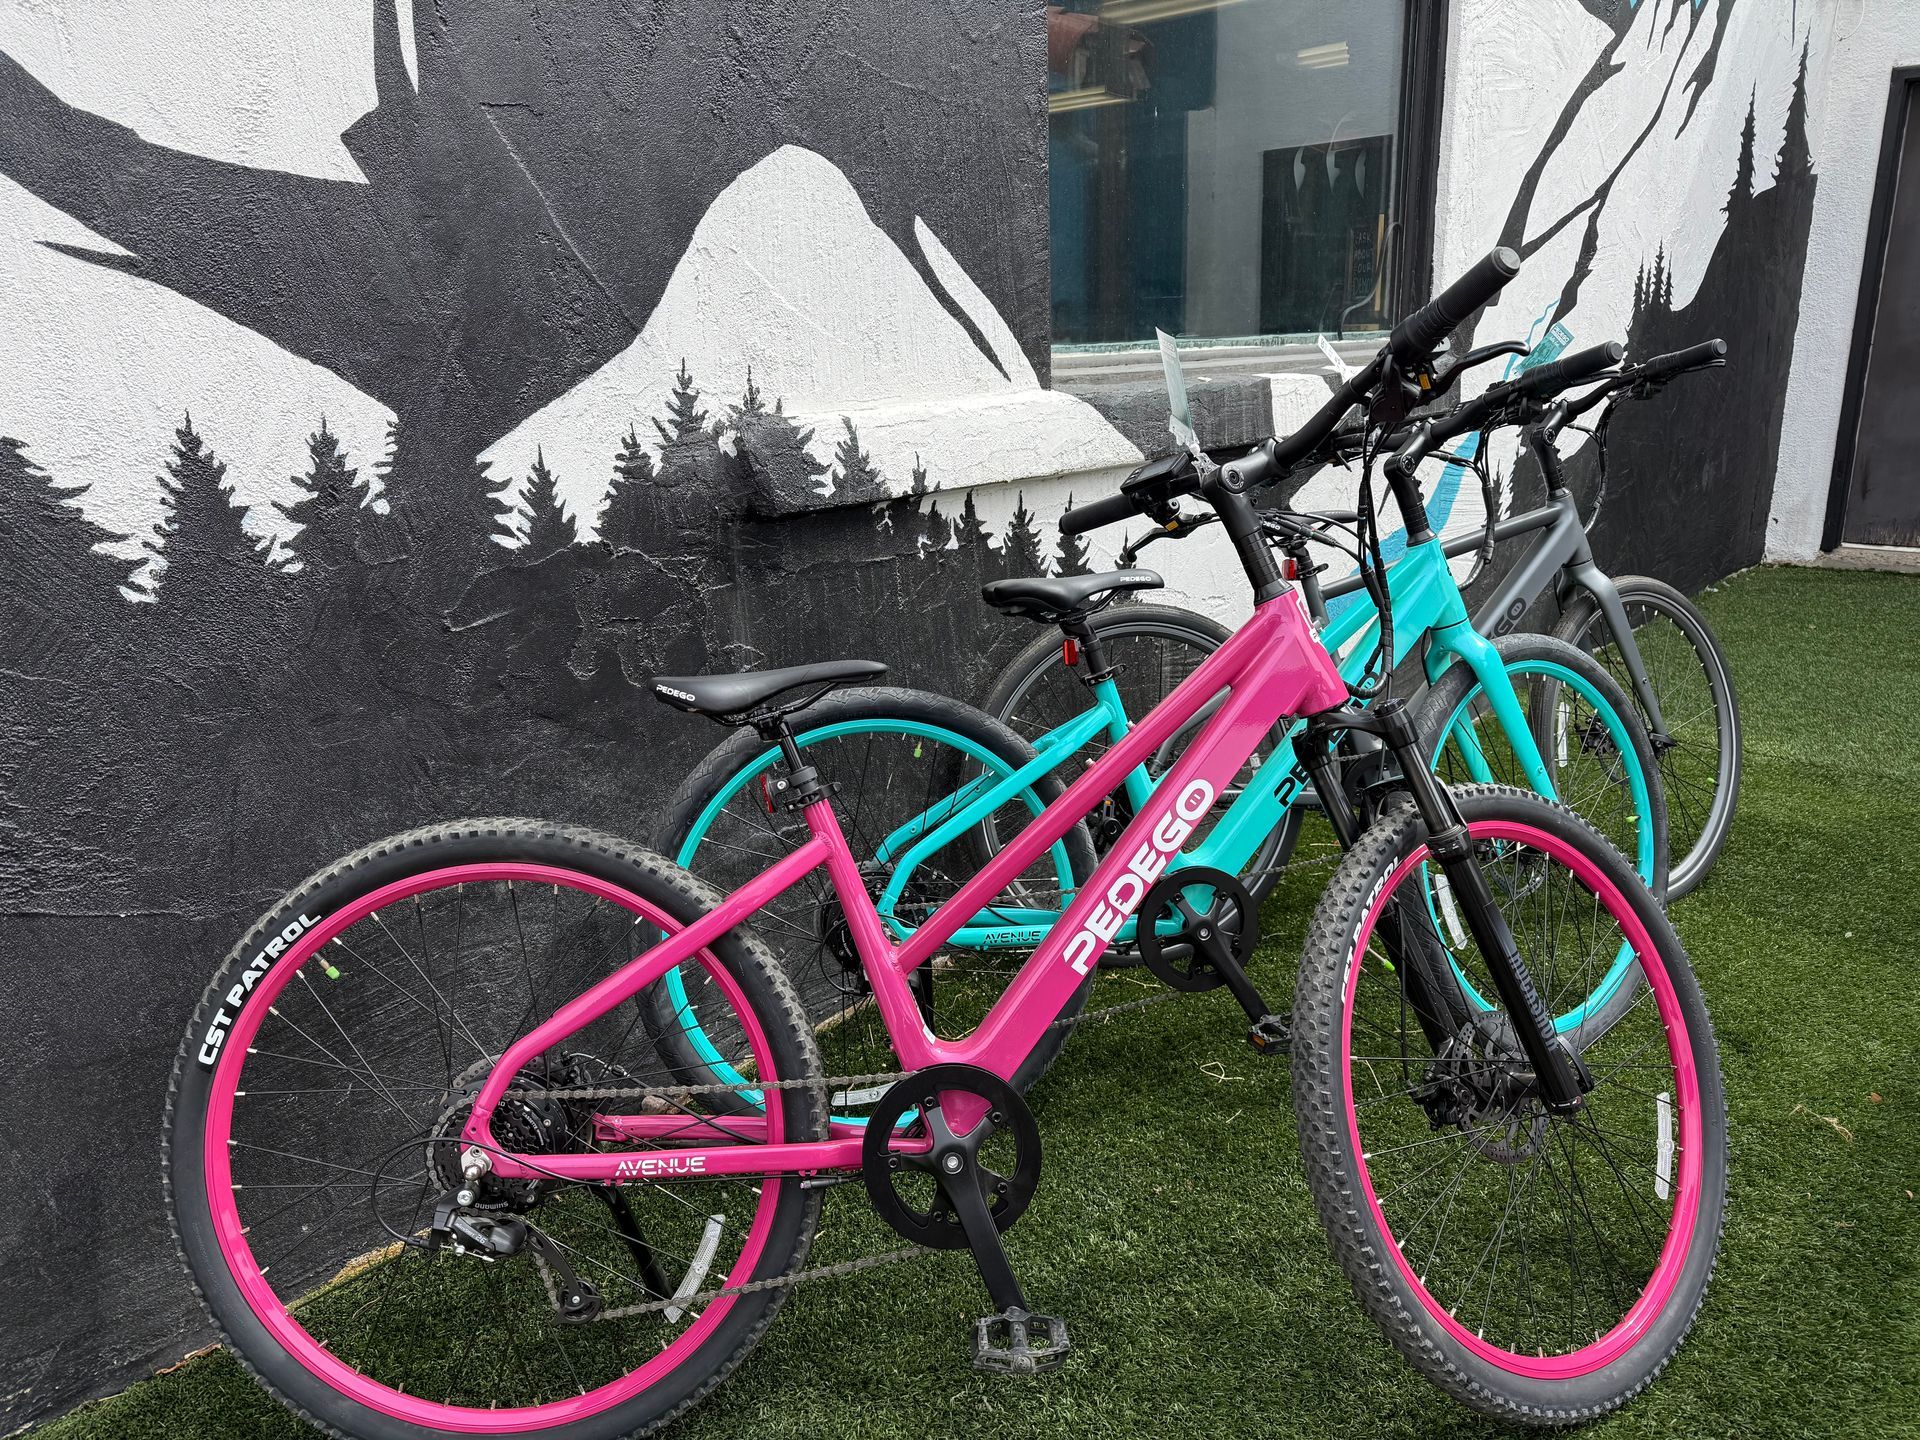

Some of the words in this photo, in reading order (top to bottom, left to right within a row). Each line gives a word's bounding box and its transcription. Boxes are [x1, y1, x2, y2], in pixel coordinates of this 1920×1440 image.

[656, 684, 696, 702] PEDEGO
[1062, 778, 1215, 976] PEDEGO
[982, 930, 1041, 945] AVENUE
[198, 1007, 233, 1065] CST
[225, 913, 322, 1008] PATROL
[615, 1156, 706, 1177] AVENUE
[474, 1202, 508, 1210] SHIMANO
